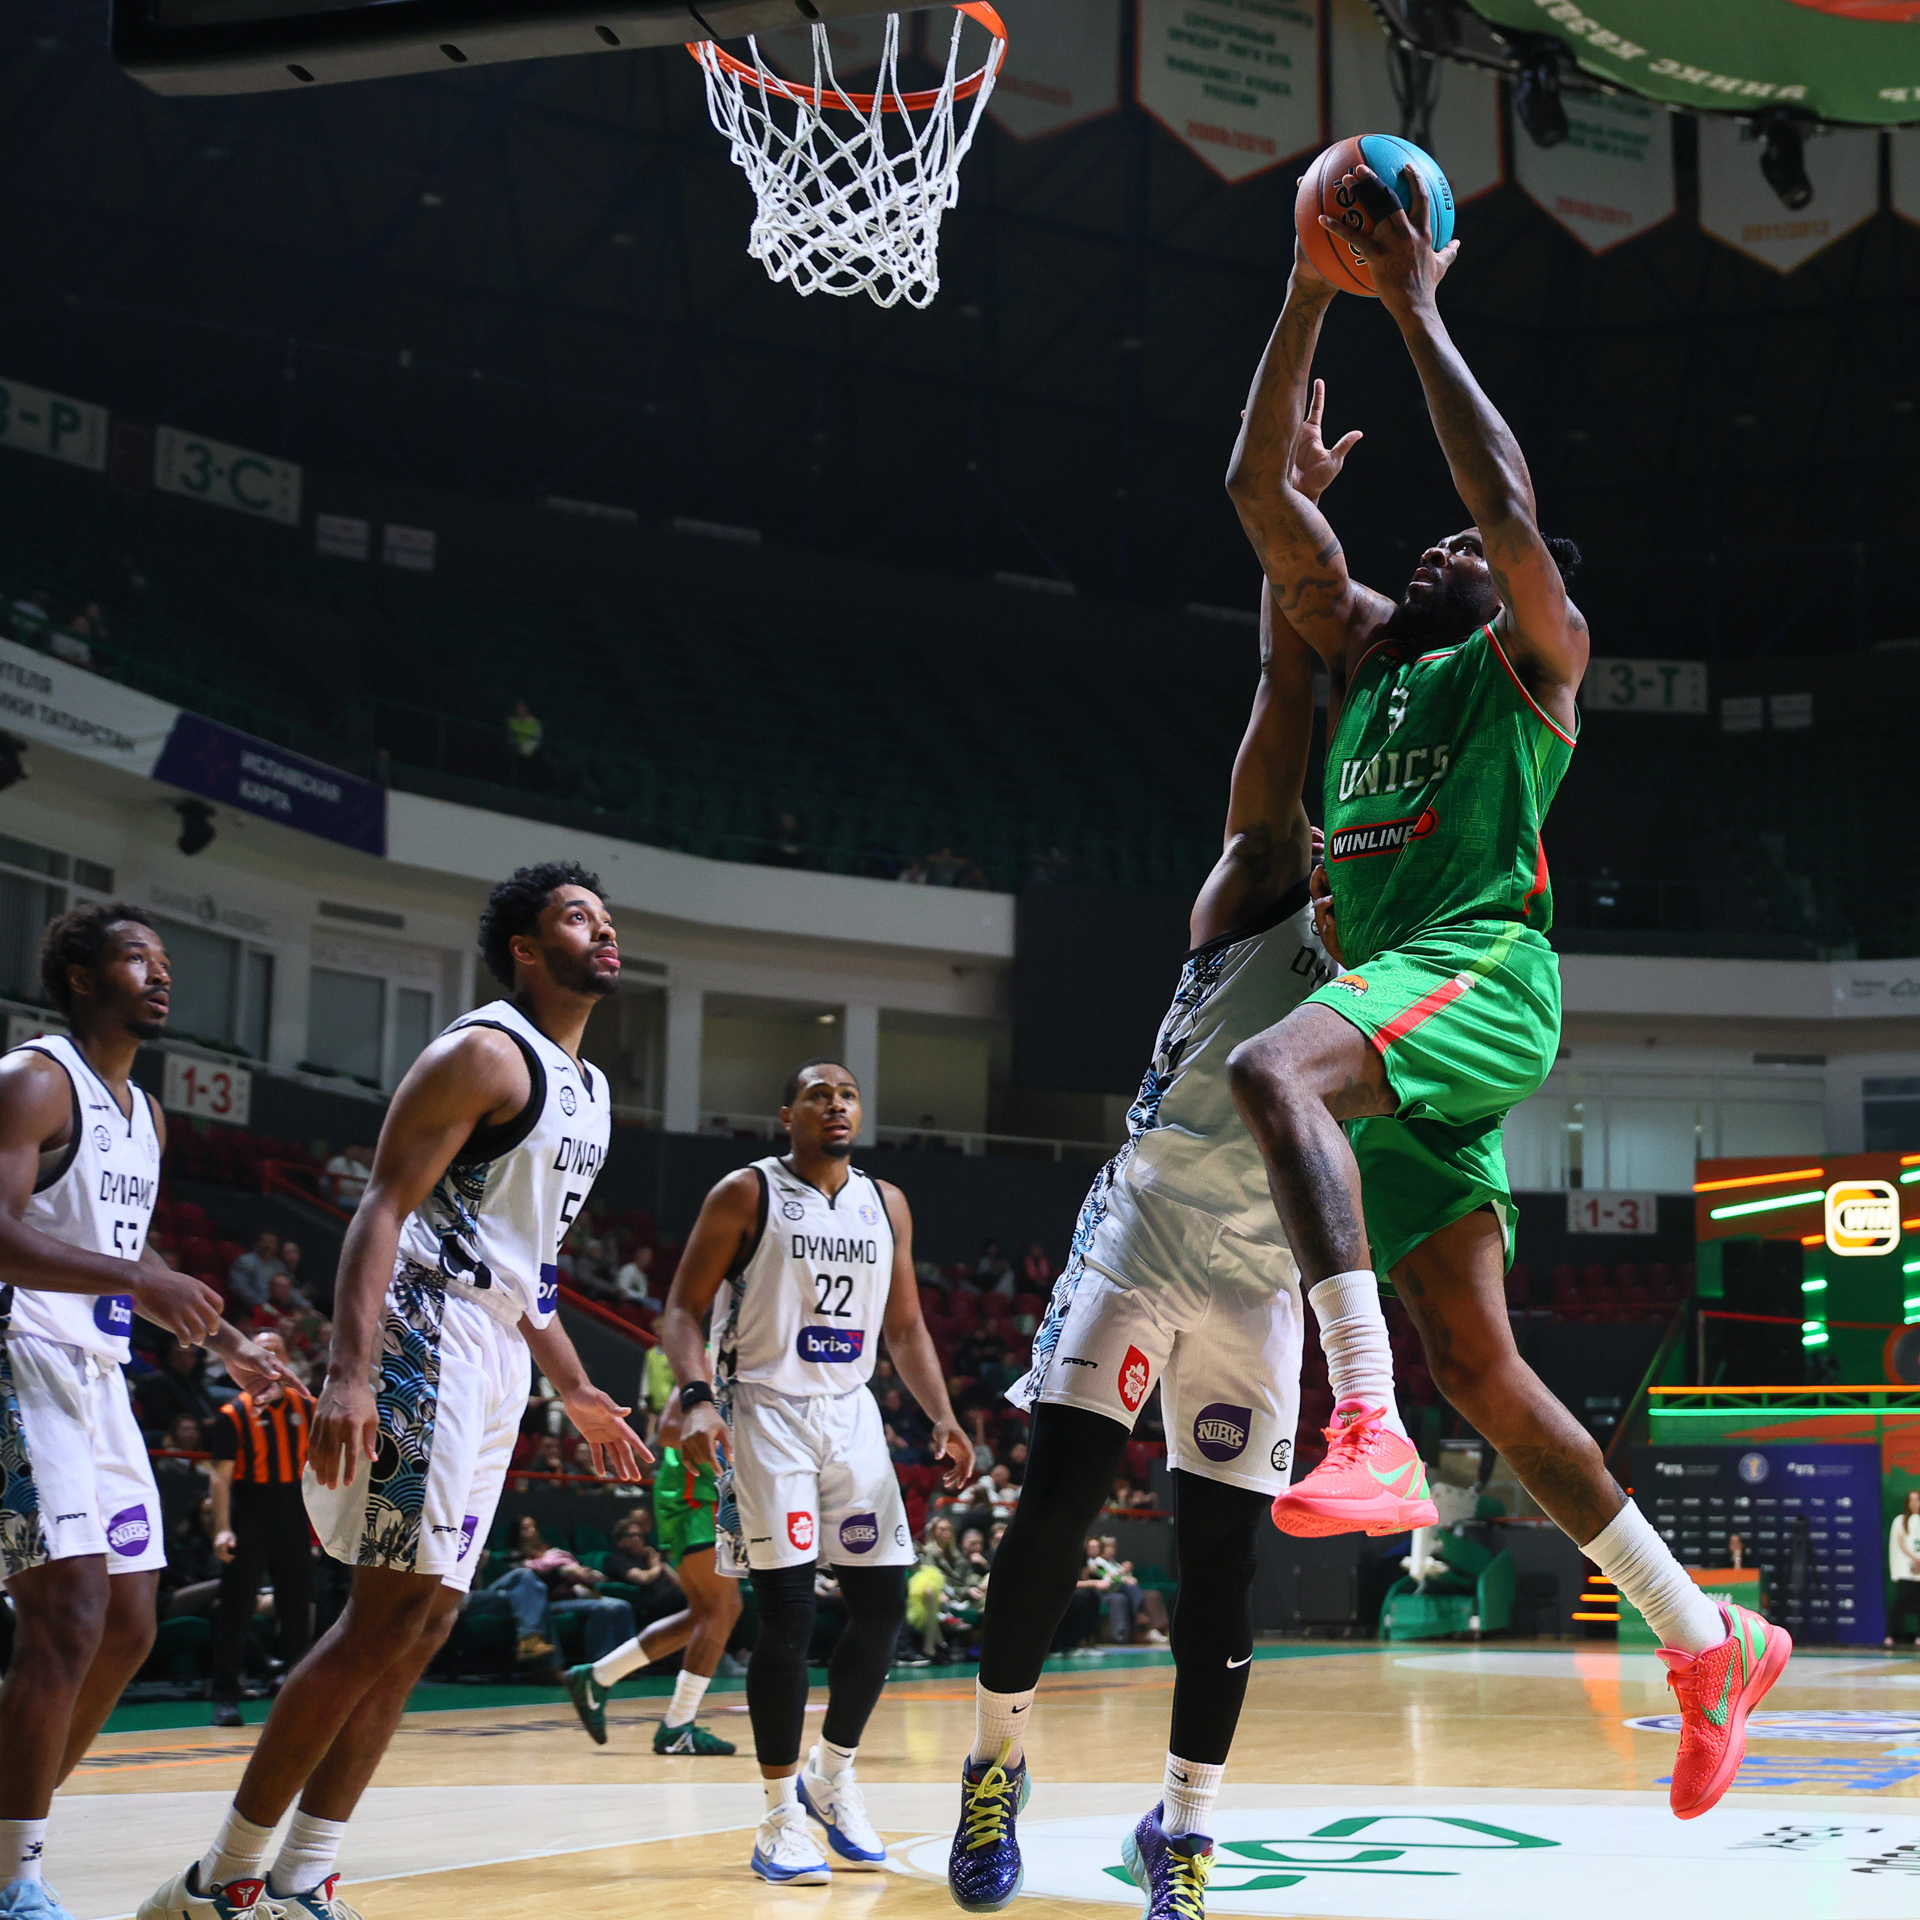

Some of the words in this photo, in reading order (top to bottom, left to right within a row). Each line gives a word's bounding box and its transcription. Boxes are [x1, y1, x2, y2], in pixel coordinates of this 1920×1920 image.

[1534, 0, 1647, 63] КАЗА
[1339, 743, 1452, 802] UNICS
[182, 1065, 233, 1114] 1-3
[1583, 1197, 1641, 1231] 1-3
[791, 1233, 878, 1266] DYNAMO
[813, 1273, 855, 1318] 22
